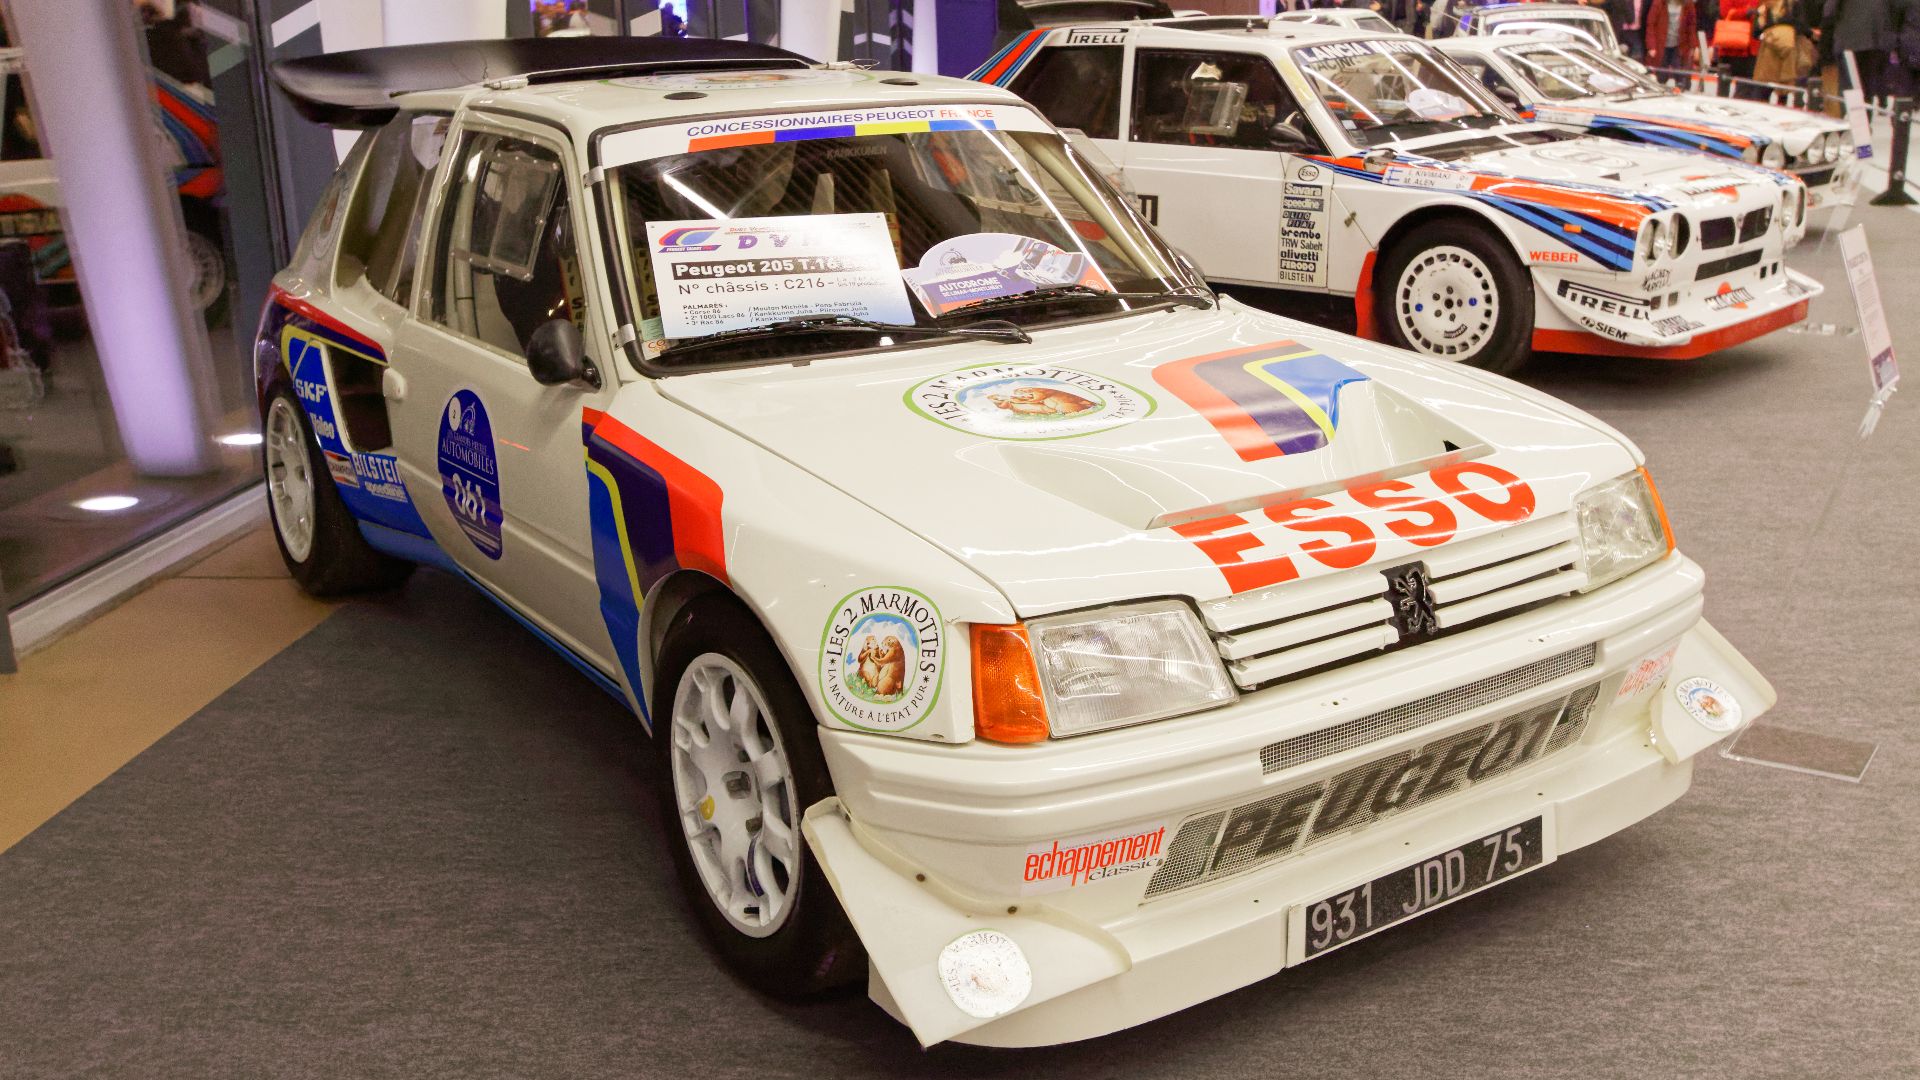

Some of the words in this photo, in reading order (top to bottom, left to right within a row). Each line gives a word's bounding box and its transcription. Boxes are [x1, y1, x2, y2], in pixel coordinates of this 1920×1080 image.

[1066, 28, 1129, 44] PIRELLI
[1298, 42, 1371, 62] LANCIA
[687, 113, 863, 137] CONCESSIONNAIRES
[866, 109, 935, 123] PEUGEOT
[1281, 227, 1321, 239] brembo
[1287, 220, 1315, 229] FIAT
[1281, 238, 1298, 248] TRW
[1300, 240, 1322, 251] Sabelt
[1280, 250, 1318, 261] olivetti
[1281, 260, 1316, 271] FERODO
[1529, 251, 1578, 263] WEBER
[675, 261, 755, 279] Peugeot
[760, 259, 795, 273] 205
[1280, 271, 1314, 283] BILSTEIN
[706, 281, 769, 294] châssis
[784, 278, 825, 290] C216
[938, 277, 1001, 293] AUTODROME
[1557, 279, 1651, 321] PIRELLI
[1595, 322, 1628, 340] SIEM
[295, 379, 327, 403] SKF
[310, 412, 335, 440] Valeo
[441, 438, 494, 475] AUTOMOBILES
[1168, 461, 1536, 595] ESSO
[827, 624, 850, 657] LES
[843, 607, 858, 625] 2
[860, 593, 939, 674] MARMOTTES
[830, 684, 864, 719] NATURE
[910, 685, 927, 709] PUR
[1207, 703, 1571, 877] PEUGEOT
[1023, 825, 1166, 887] echappement
[1311, 881, 1373, 951] 931
[1402, 849, 1466, 915] JDD
[1483, 827, 1523, 882] 75
